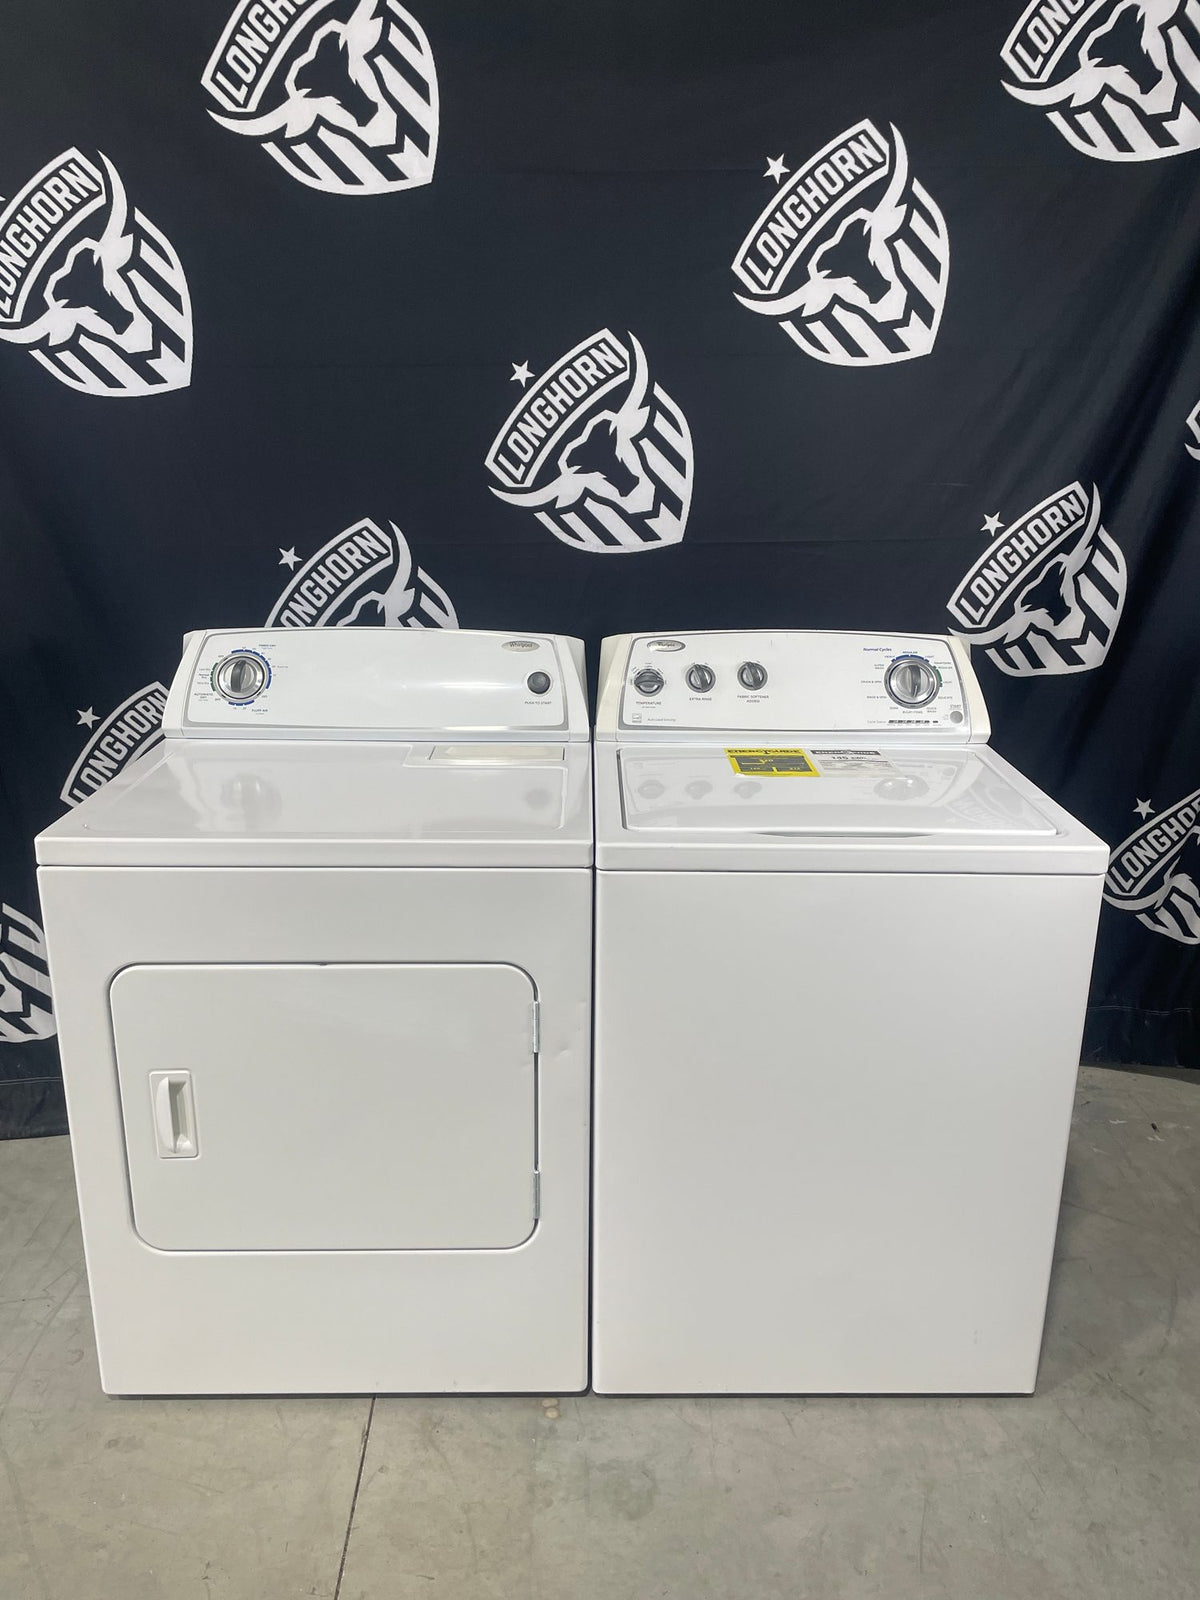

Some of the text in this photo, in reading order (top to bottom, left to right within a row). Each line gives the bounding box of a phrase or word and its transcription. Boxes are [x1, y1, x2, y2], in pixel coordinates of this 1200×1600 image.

[216, 0, 307, 105] LONGH
[745, 134, 884, 287] LONGHORN
[497, 342, 626, 482] LONGHORN
[280, 529, 389, 627] ONGHORN
[959, 493, 1074, 623] LONGHORN
[1110, 797, 1200, 891] LONGHO
